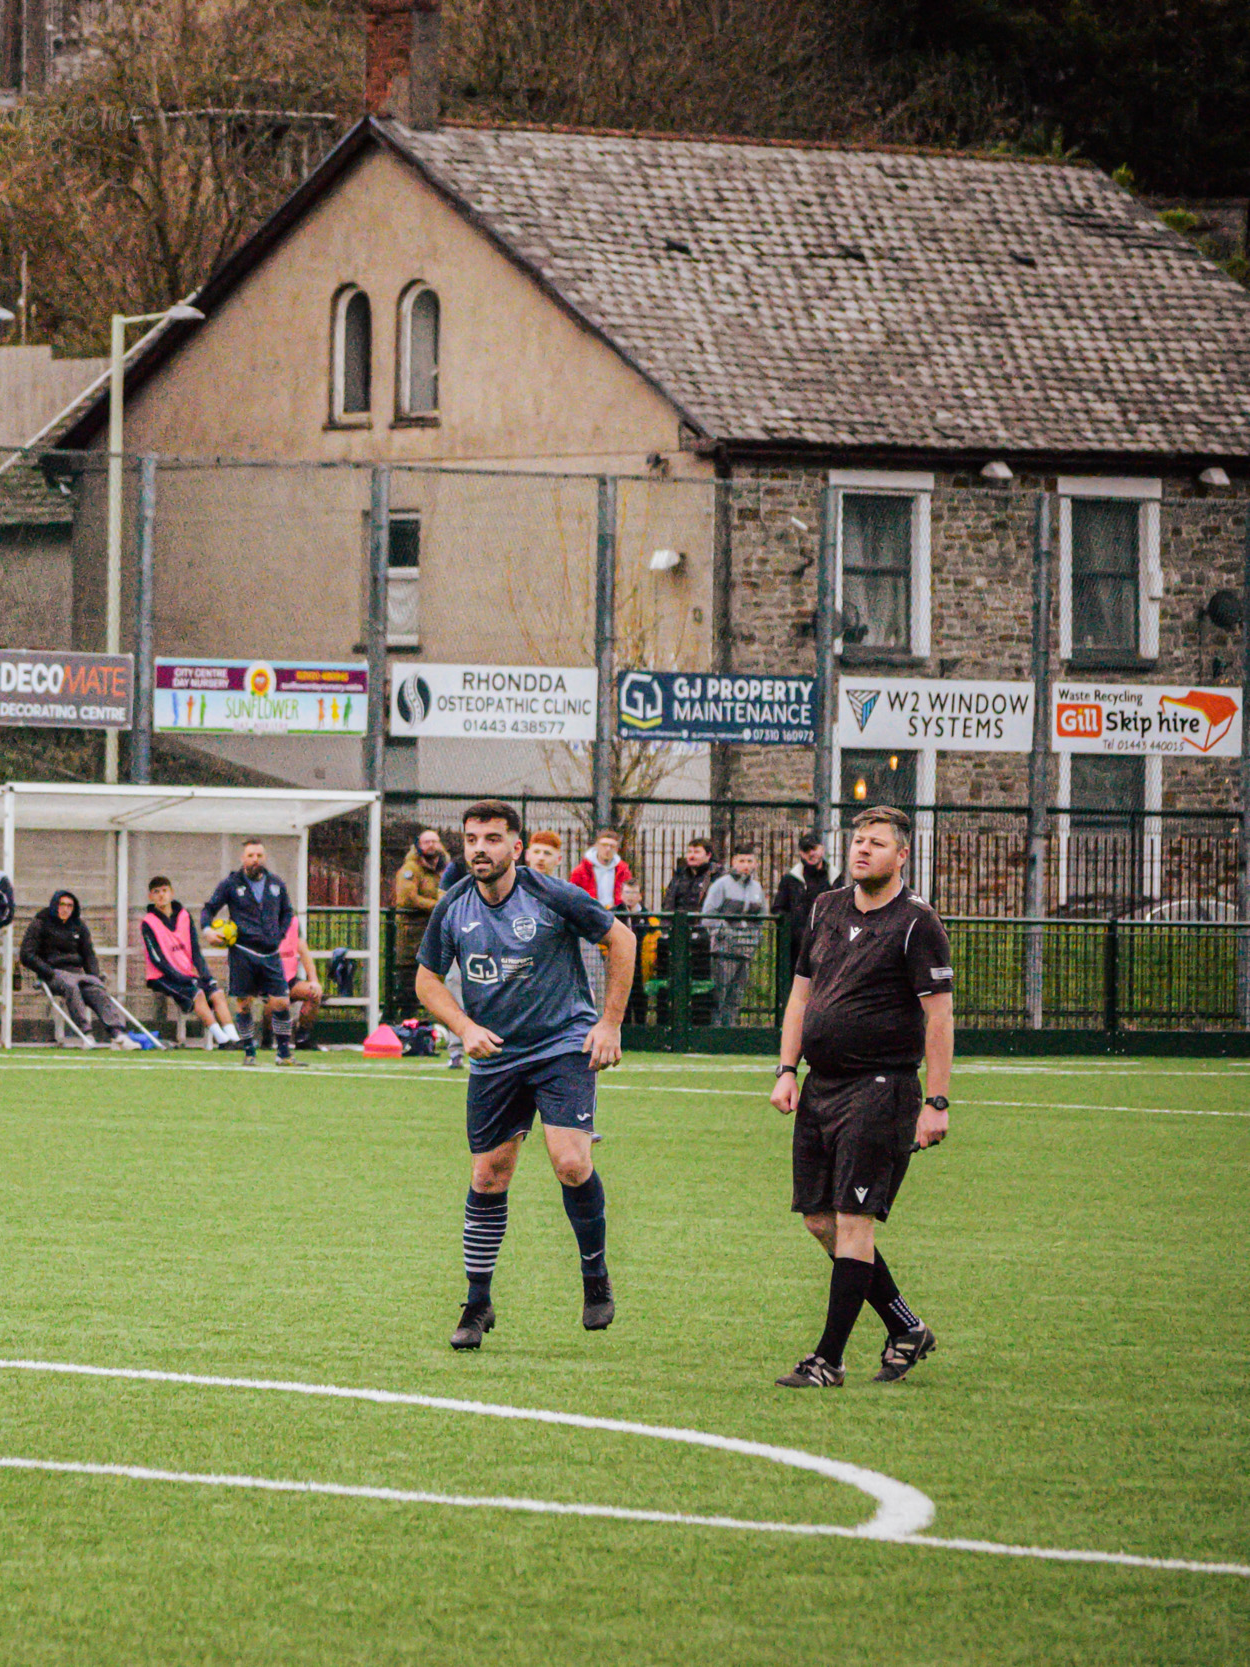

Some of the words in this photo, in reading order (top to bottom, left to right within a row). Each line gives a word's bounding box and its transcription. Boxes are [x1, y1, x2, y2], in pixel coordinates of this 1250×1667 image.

[172, 677, 190, 688] DAY
[190, 678, 230, 689] NURSERY
[462, 671, 567, 693] RHONDDA
[673, 677, 702, 699] GJ
[707, 678, 813, 702] PROPERTY
[225, 696, 299, 720] SUNFLOWER
[437, 695, 539, 714] OSTEOPATHIC
[543, 699, 592, 716] CLINIC
[887, 691, 920, 712] W2
[928, 692, 1029, 715] WINDOW
[1058, 688, 1090, 700] Waste
[1094, 689, 1143, 707] Recycling
[0, 703, 77, 718] DECORATING
[80, 706, 126, 722] CENTRE
[673, 700, 812, 725] MAINTENANCE
[1060, 708, 1099, 732] Gill
[1106, 710, 1152, 738] Skip
[1157, 711, 1200, 733] hire
[463, 719, 507, 732] 01443
[511, 720, 565, 735] 438577
[908, 715, 1004, 739] SYSTEMS
[1103, 739, 1114, 749] Tel
[1117, 740, 1147, 751] 01443
